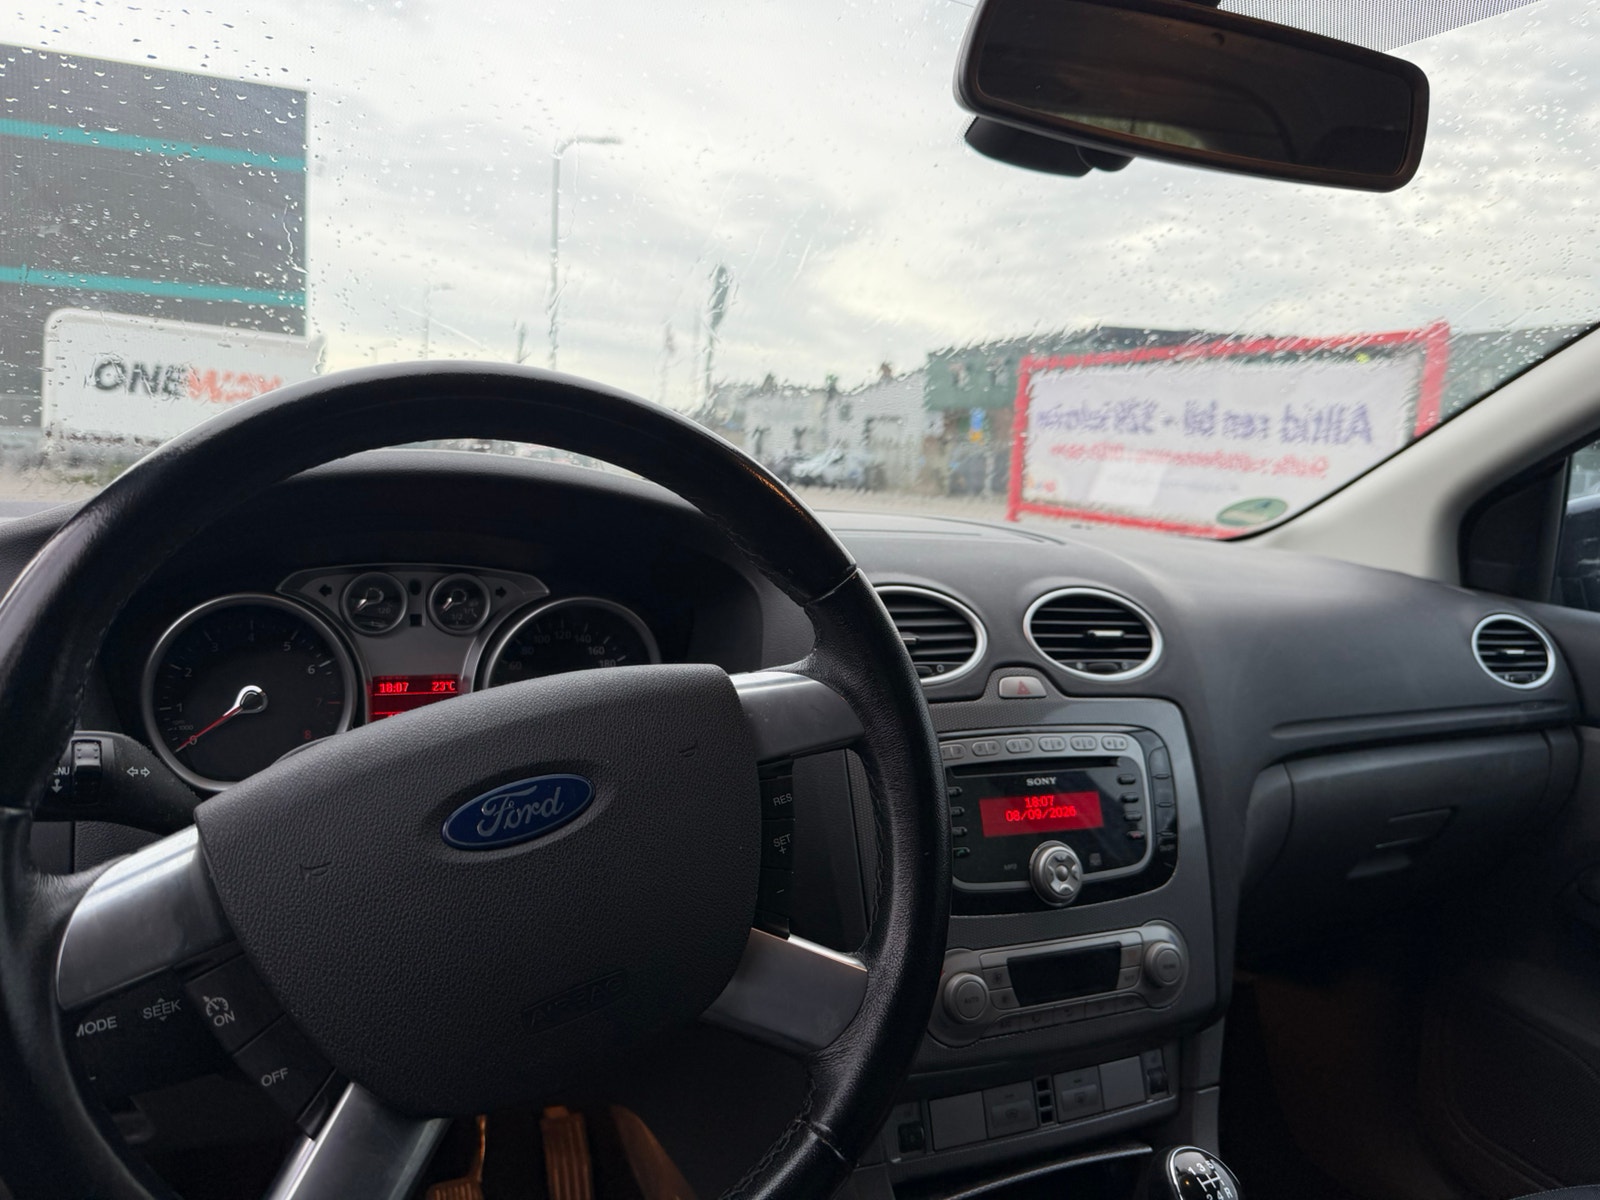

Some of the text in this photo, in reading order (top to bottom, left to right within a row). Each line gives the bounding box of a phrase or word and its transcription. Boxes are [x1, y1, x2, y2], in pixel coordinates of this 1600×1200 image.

[283, 641, 292, 651] 5
[587, 646, 605, 656] 160
[184, 667, 193, 677] 2
[307, 664, 316, 675] 6
[379, 682, 409, 693] 18:07
[303, 729, 312, 739] 8
[1026, 776, 1057, 786] SONY
[772, 793, 793, 807] RES
[1024, 794, 1055, 808] 18:07
[476, 785, 564, 837] Ford
[772, 833, 792, 848] SET
[142, 999, 182, 1020] SEEK
[212, 1010, 236, 1028] ON
[260, 1067, 290, 1087] OFF
[1187, 1160, 1215, 1176] 1 3 5
[1223, 1186, 1234, 1199] R
